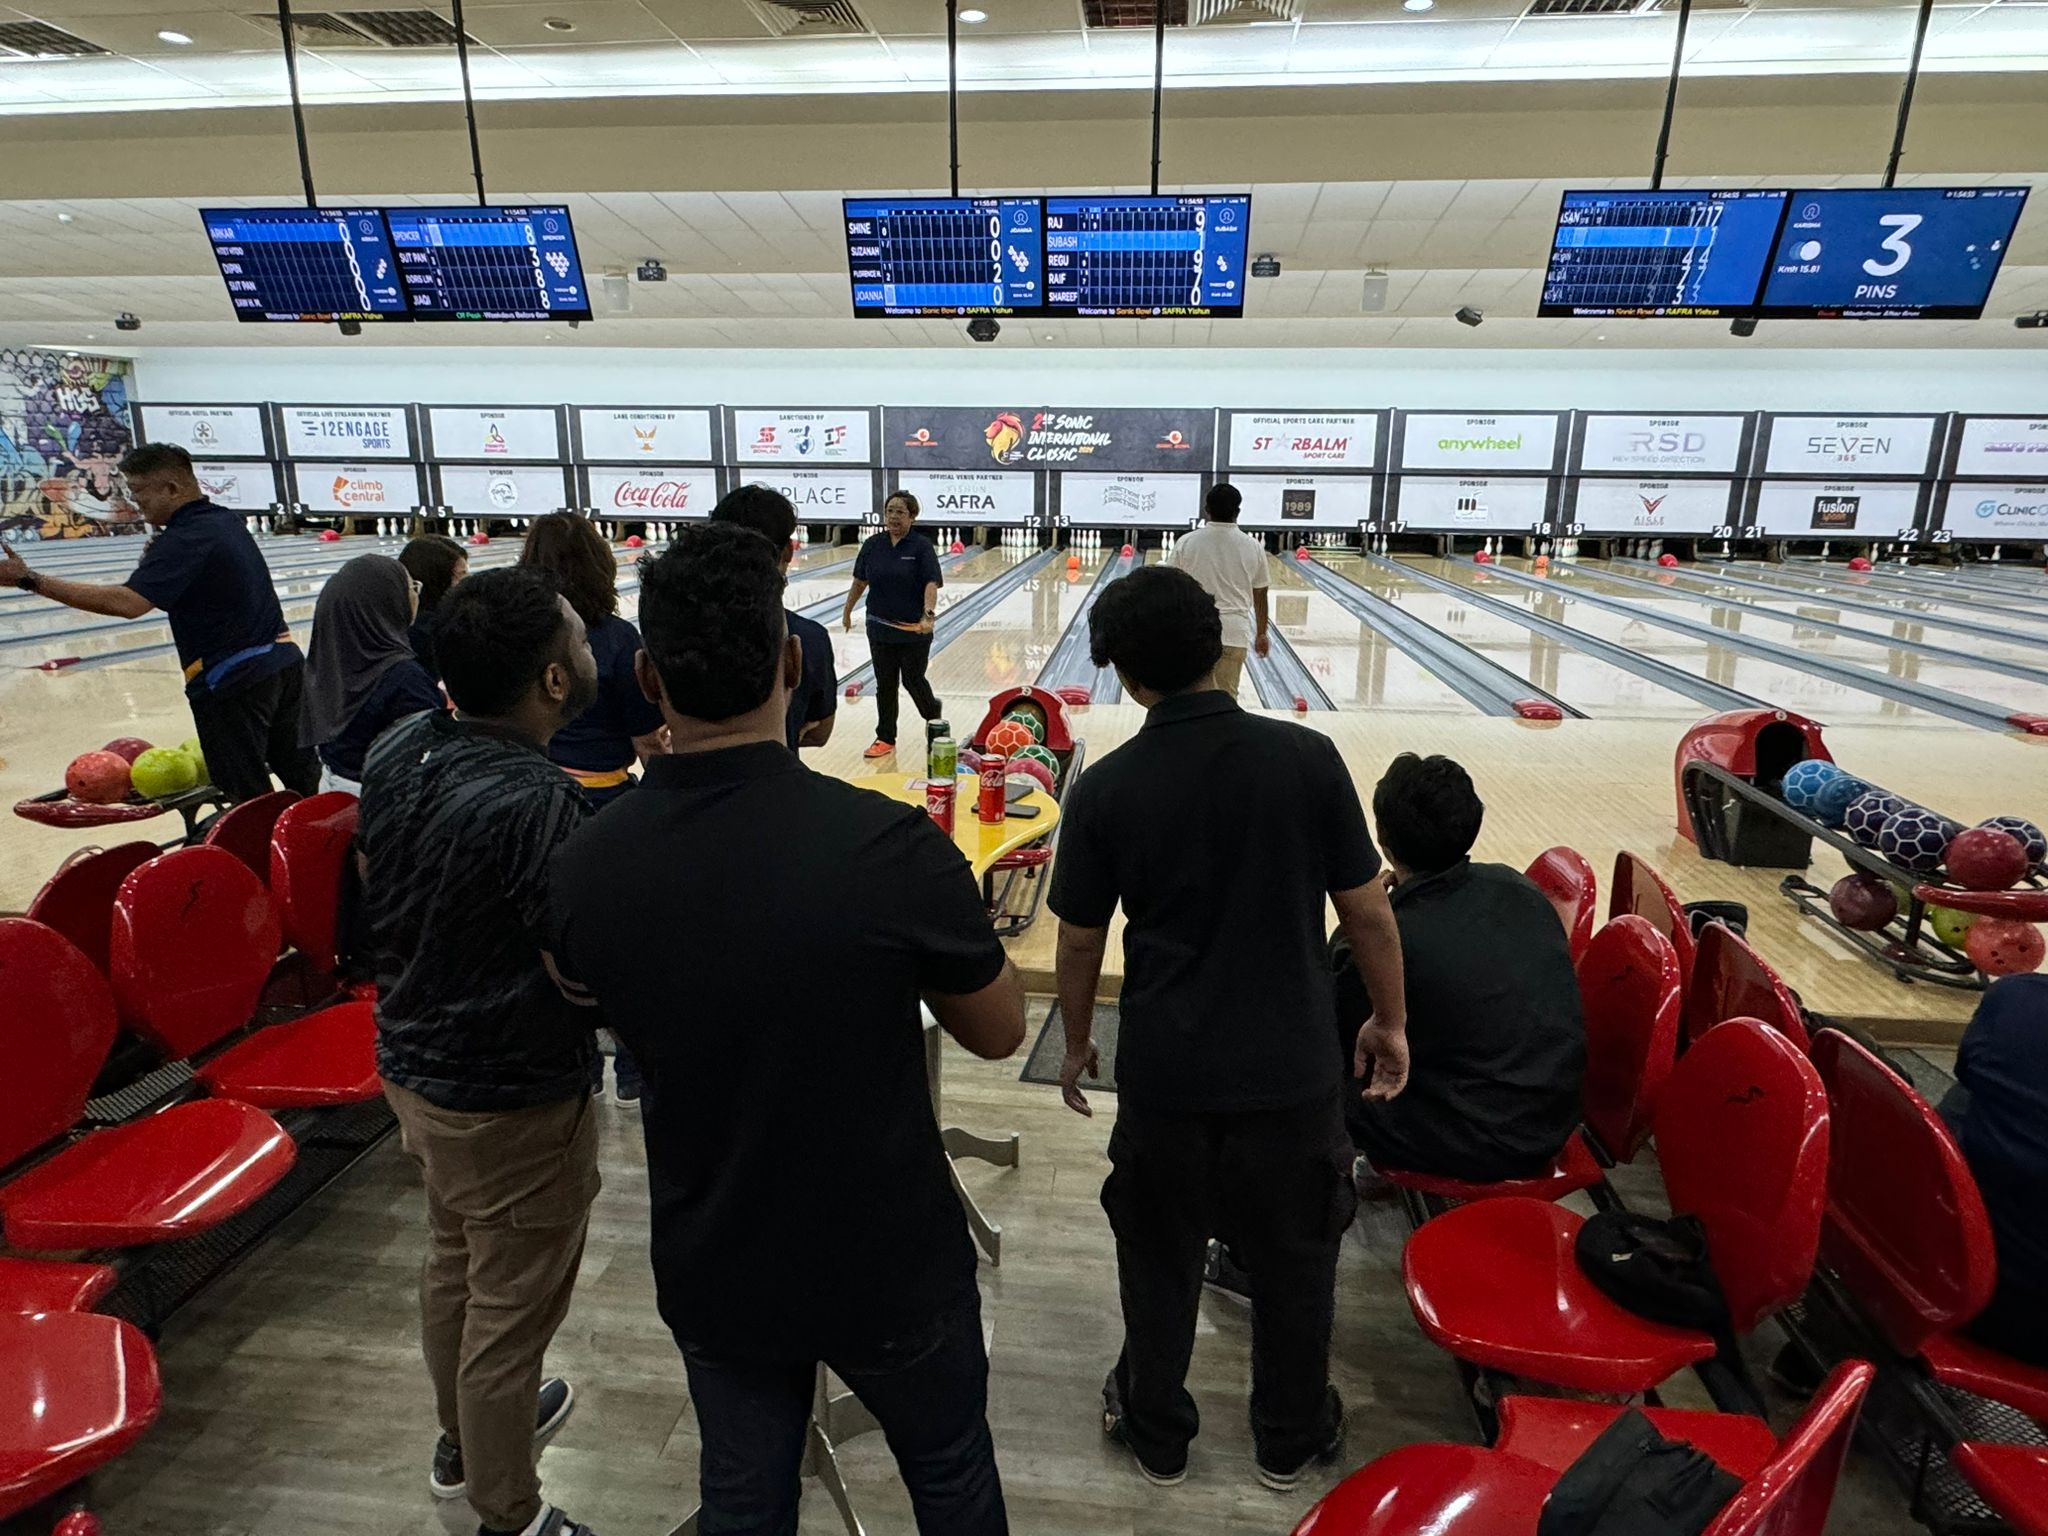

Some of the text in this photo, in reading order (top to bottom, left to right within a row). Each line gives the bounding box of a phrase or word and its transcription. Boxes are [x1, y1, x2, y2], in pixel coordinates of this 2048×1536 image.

[990, 216, 1000, 238] 0
[1048, 216, 1063, 229] RAJ
[1196, 211, 1205, 232] 9
[848, 222, 871, 234] SHINE
[1048, 236, 1077, 248] SUBASH
[1862, 214, 1924, 277] 3
[991, 239, 1001, 261] 0
[1048, 255, 1069, 266] REGU
[993, 263, 1002, 283] 2
[1049, 273, 1066, 284] RAIF
[856, 290, 884, 301] JOANNA
[993, 285, 1002, 306] 0
[1049, 292, 1078, 302] SHAREEF
[1854, 284, 1898, 298] PINS
[1054, 414, 1093, 430] SONIC
[320, 421, 390, 437] 12ENGAGE
[362, 439, 391, 448] SPORTS
[1028, 430, 1112, 446] INTERNATIONAL
[1438, 432, 1522, 452] anywheel
[1629, 432, 1706, 452] RSD
[1806, 437, 1892, 454] SEVEN
[1027, 448, 1078, 461] CLASSIC
[351, 480, 383, 490] climb
[344, 492, 385, 502] central
[614, 481, 692, 508] Coca-Cola
[937, 495, 996, 509] SAFRA
[1285, 502, 1312, 512] 1989
[1818, 498, 1855, 513] fusion
[277, 503, 285, 514] 2
[293, 503, 301, 514] 3
[419, 507, 428, 517] 4
[438, 507, 446, 517] 5
[584, 508, 592, 519] 7
[864, 513, 880, 524] 10
[1026, 517, 1041, 527] 12
[1053, 516, 1069, 526] 13
[1360, 522, 1376, 533] 16
[1390, 521, 1406, 533] 17
[1534, 523, 1551, 534] 18
[1566, 524, 1582, 535] 19
[1713, 526, 1732, 538] 20
[1745, 526, 1762, 538] 21
[1899, 529, 1919, 541] 22
[1931, 530, 1951, 542] 23
